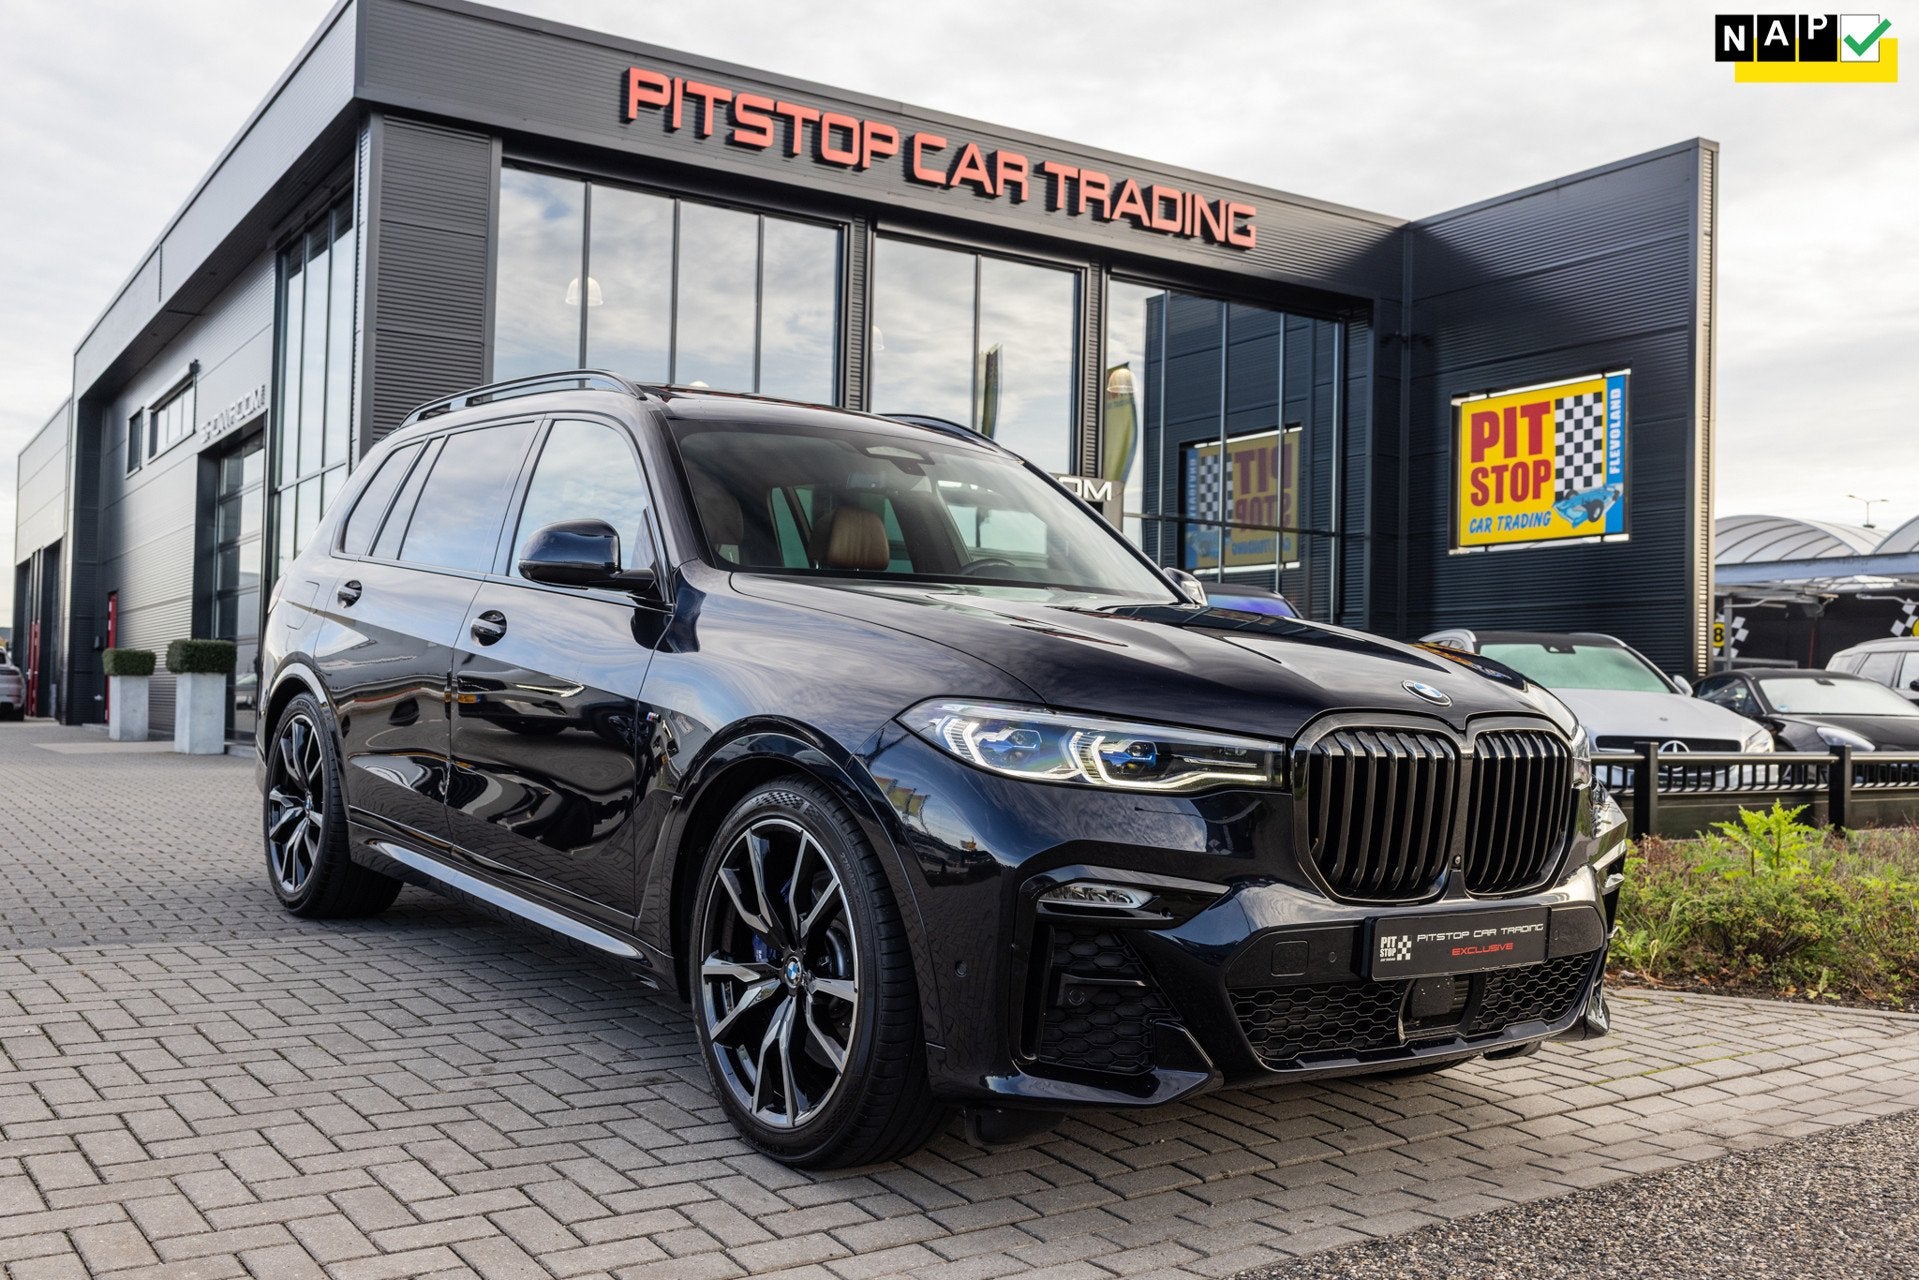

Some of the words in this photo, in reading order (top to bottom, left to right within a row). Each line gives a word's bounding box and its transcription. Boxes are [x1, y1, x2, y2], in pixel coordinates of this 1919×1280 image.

[625, 67, 900, 170] PITSTOP
[911, 131, 1029, 202] CAR
[1042, 160, 1257, 249] TRADING
[1471, 401, 1551, 464] PIT
[1609, 387, 1622, 475] FLEVOLAND
[1470, 459, 1551, 507] STOP
[1469, 516, 1493, 534] CAR
[1497, 511, 1552, 532] TRADING
[1380, 936, 1398, 948] PIT
[1417, 930, 1470, 943] PITSTOP
[1473, 928, 1498, 938] CAR
[1501, 923, 1544, 935] TRADING
[1380, 947, 1397, 957] STOP
[1452, 942, 1514, 956] EXCLUSIVE
